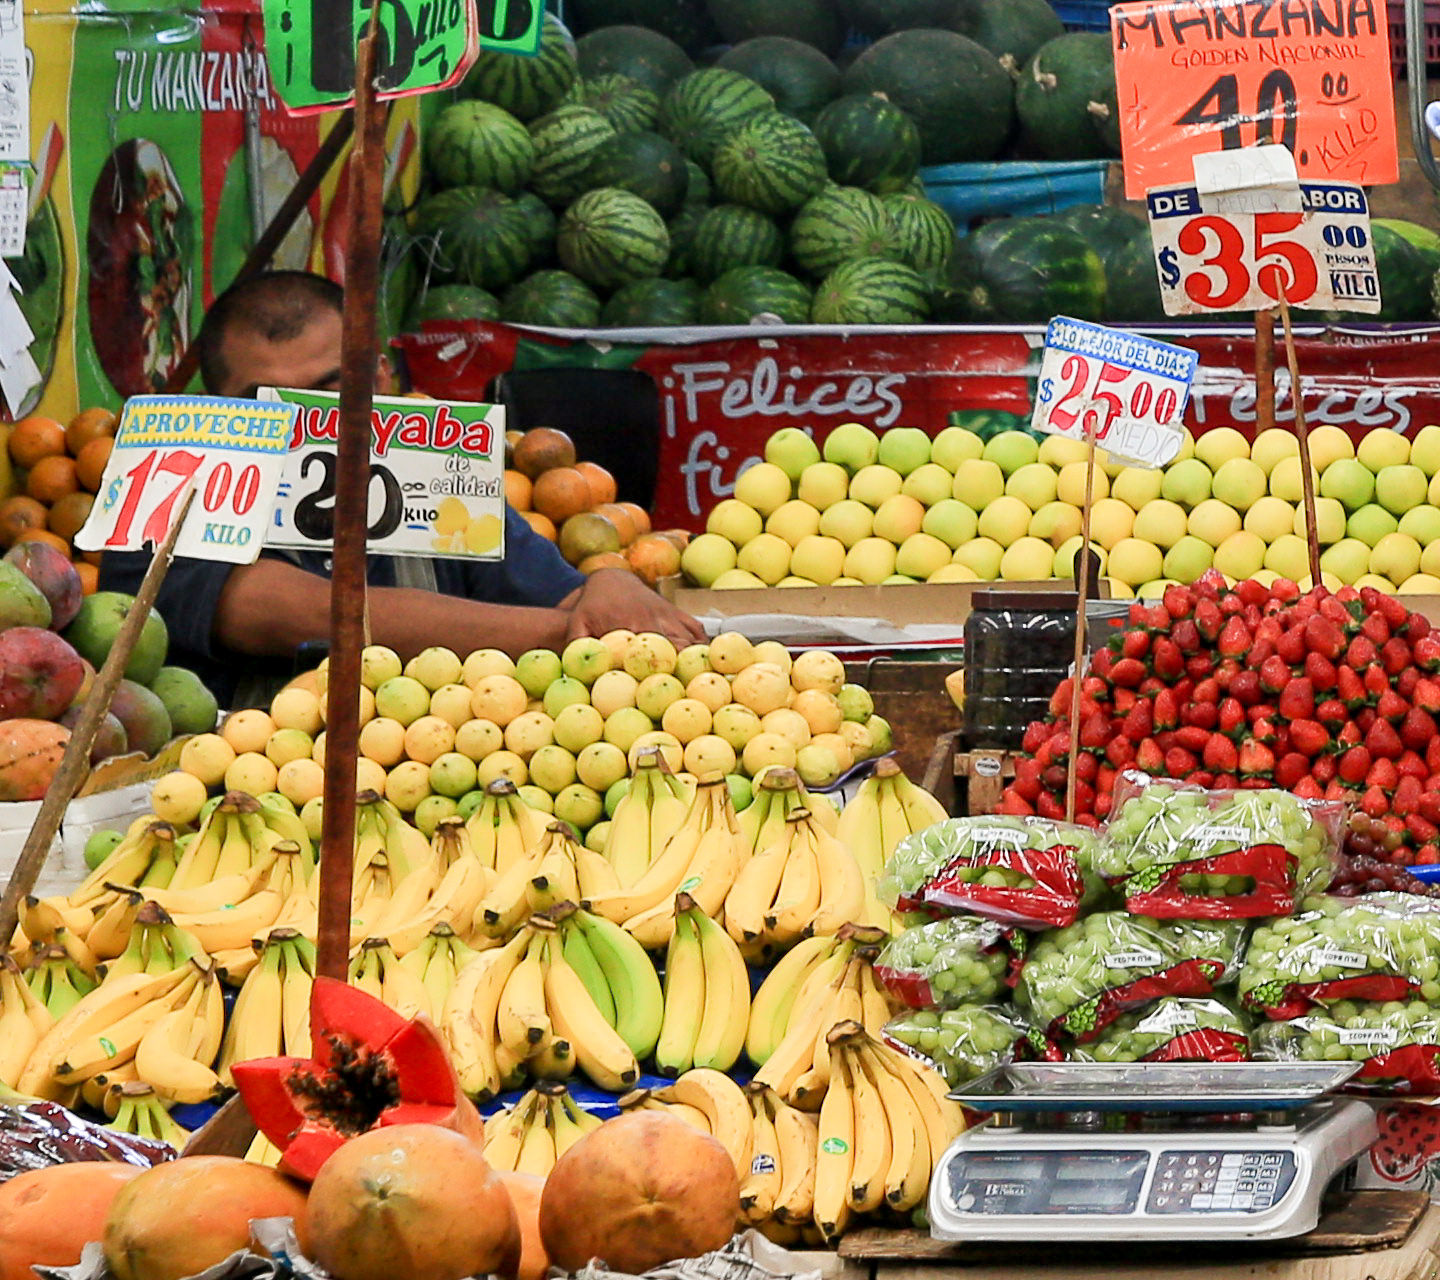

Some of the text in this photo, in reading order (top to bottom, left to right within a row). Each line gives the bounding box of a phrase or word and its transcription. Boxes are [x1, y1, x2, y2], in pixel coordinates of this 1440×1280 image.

[1171, 39, 1366, 69] GOLDEN NACIONAL
[114, 51, 148, 112] TU
[1315, 108, 1379, 172] KILO
[1154, 193, 1191, 215] DE
[1322, 224, 1368, 249] 00
[1325, 253, 1370, 268] PESOS
[1331, 272, 1379, 297] KILO
[1062, 328, 1077, 344] LO
[1126, 346, 1151, 363] DEL
[1155, 353, 1178, 370] DIA
[1131, 381, 1177, 425] 00
[128, 412, 286, 443] APROVECHE
[289, 404, 494, 458] guyaba
[1106, 417, 1182, 465] MEDIO
[444, 453, 472, 475] de
[202, 461, 262, 517] 00
[428, 474, 501, 500] calidad
[200, 522, 252, 547] KILO
